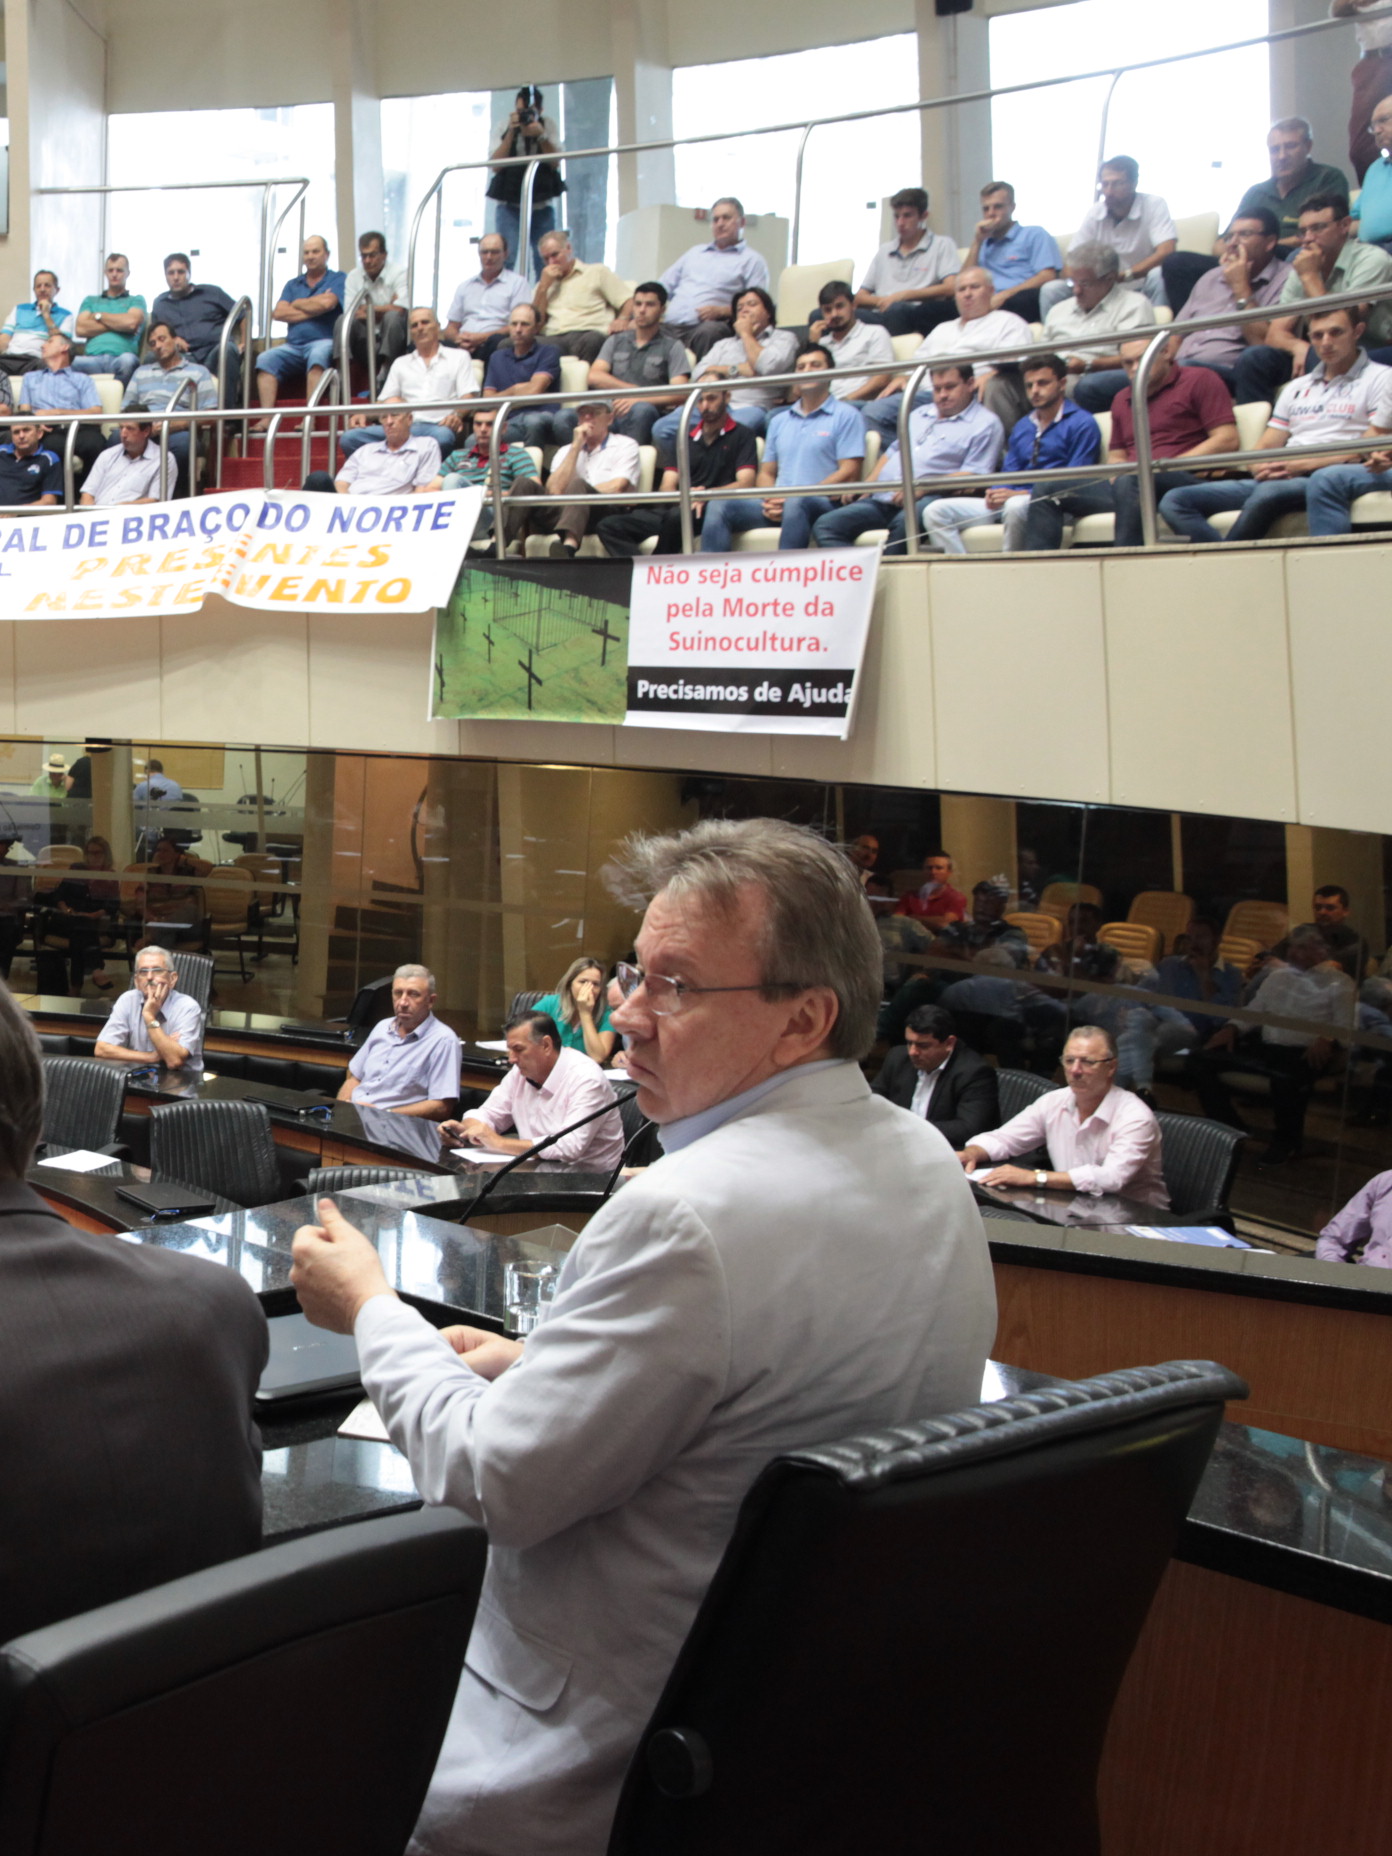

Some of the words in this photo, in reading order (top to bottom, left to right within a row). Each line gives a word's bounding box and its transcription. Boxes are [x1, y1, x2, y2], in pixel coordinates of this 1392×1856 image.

[62, 520, 110, 550] DE
[121, 503, 251, 545] BRAÇO
[256, 501, 311, 532] DO
[326, 500, 456, 534] NORTE
[646, 563, 690, 585] Não
[698, 562, 742, 589] seja
[751, 559, 864, 588] cúmplice
[23, 579, 206, 612] NESTE
[666, 597, 714, 623] pela
[722, 597, 795, 618] Morte
[804, 595, 835, 617] da
[668, 630, 829, 653] Suinocultura.
[636, 679, 749, 702] Precisamos
[754, 681, 782, 703] de
